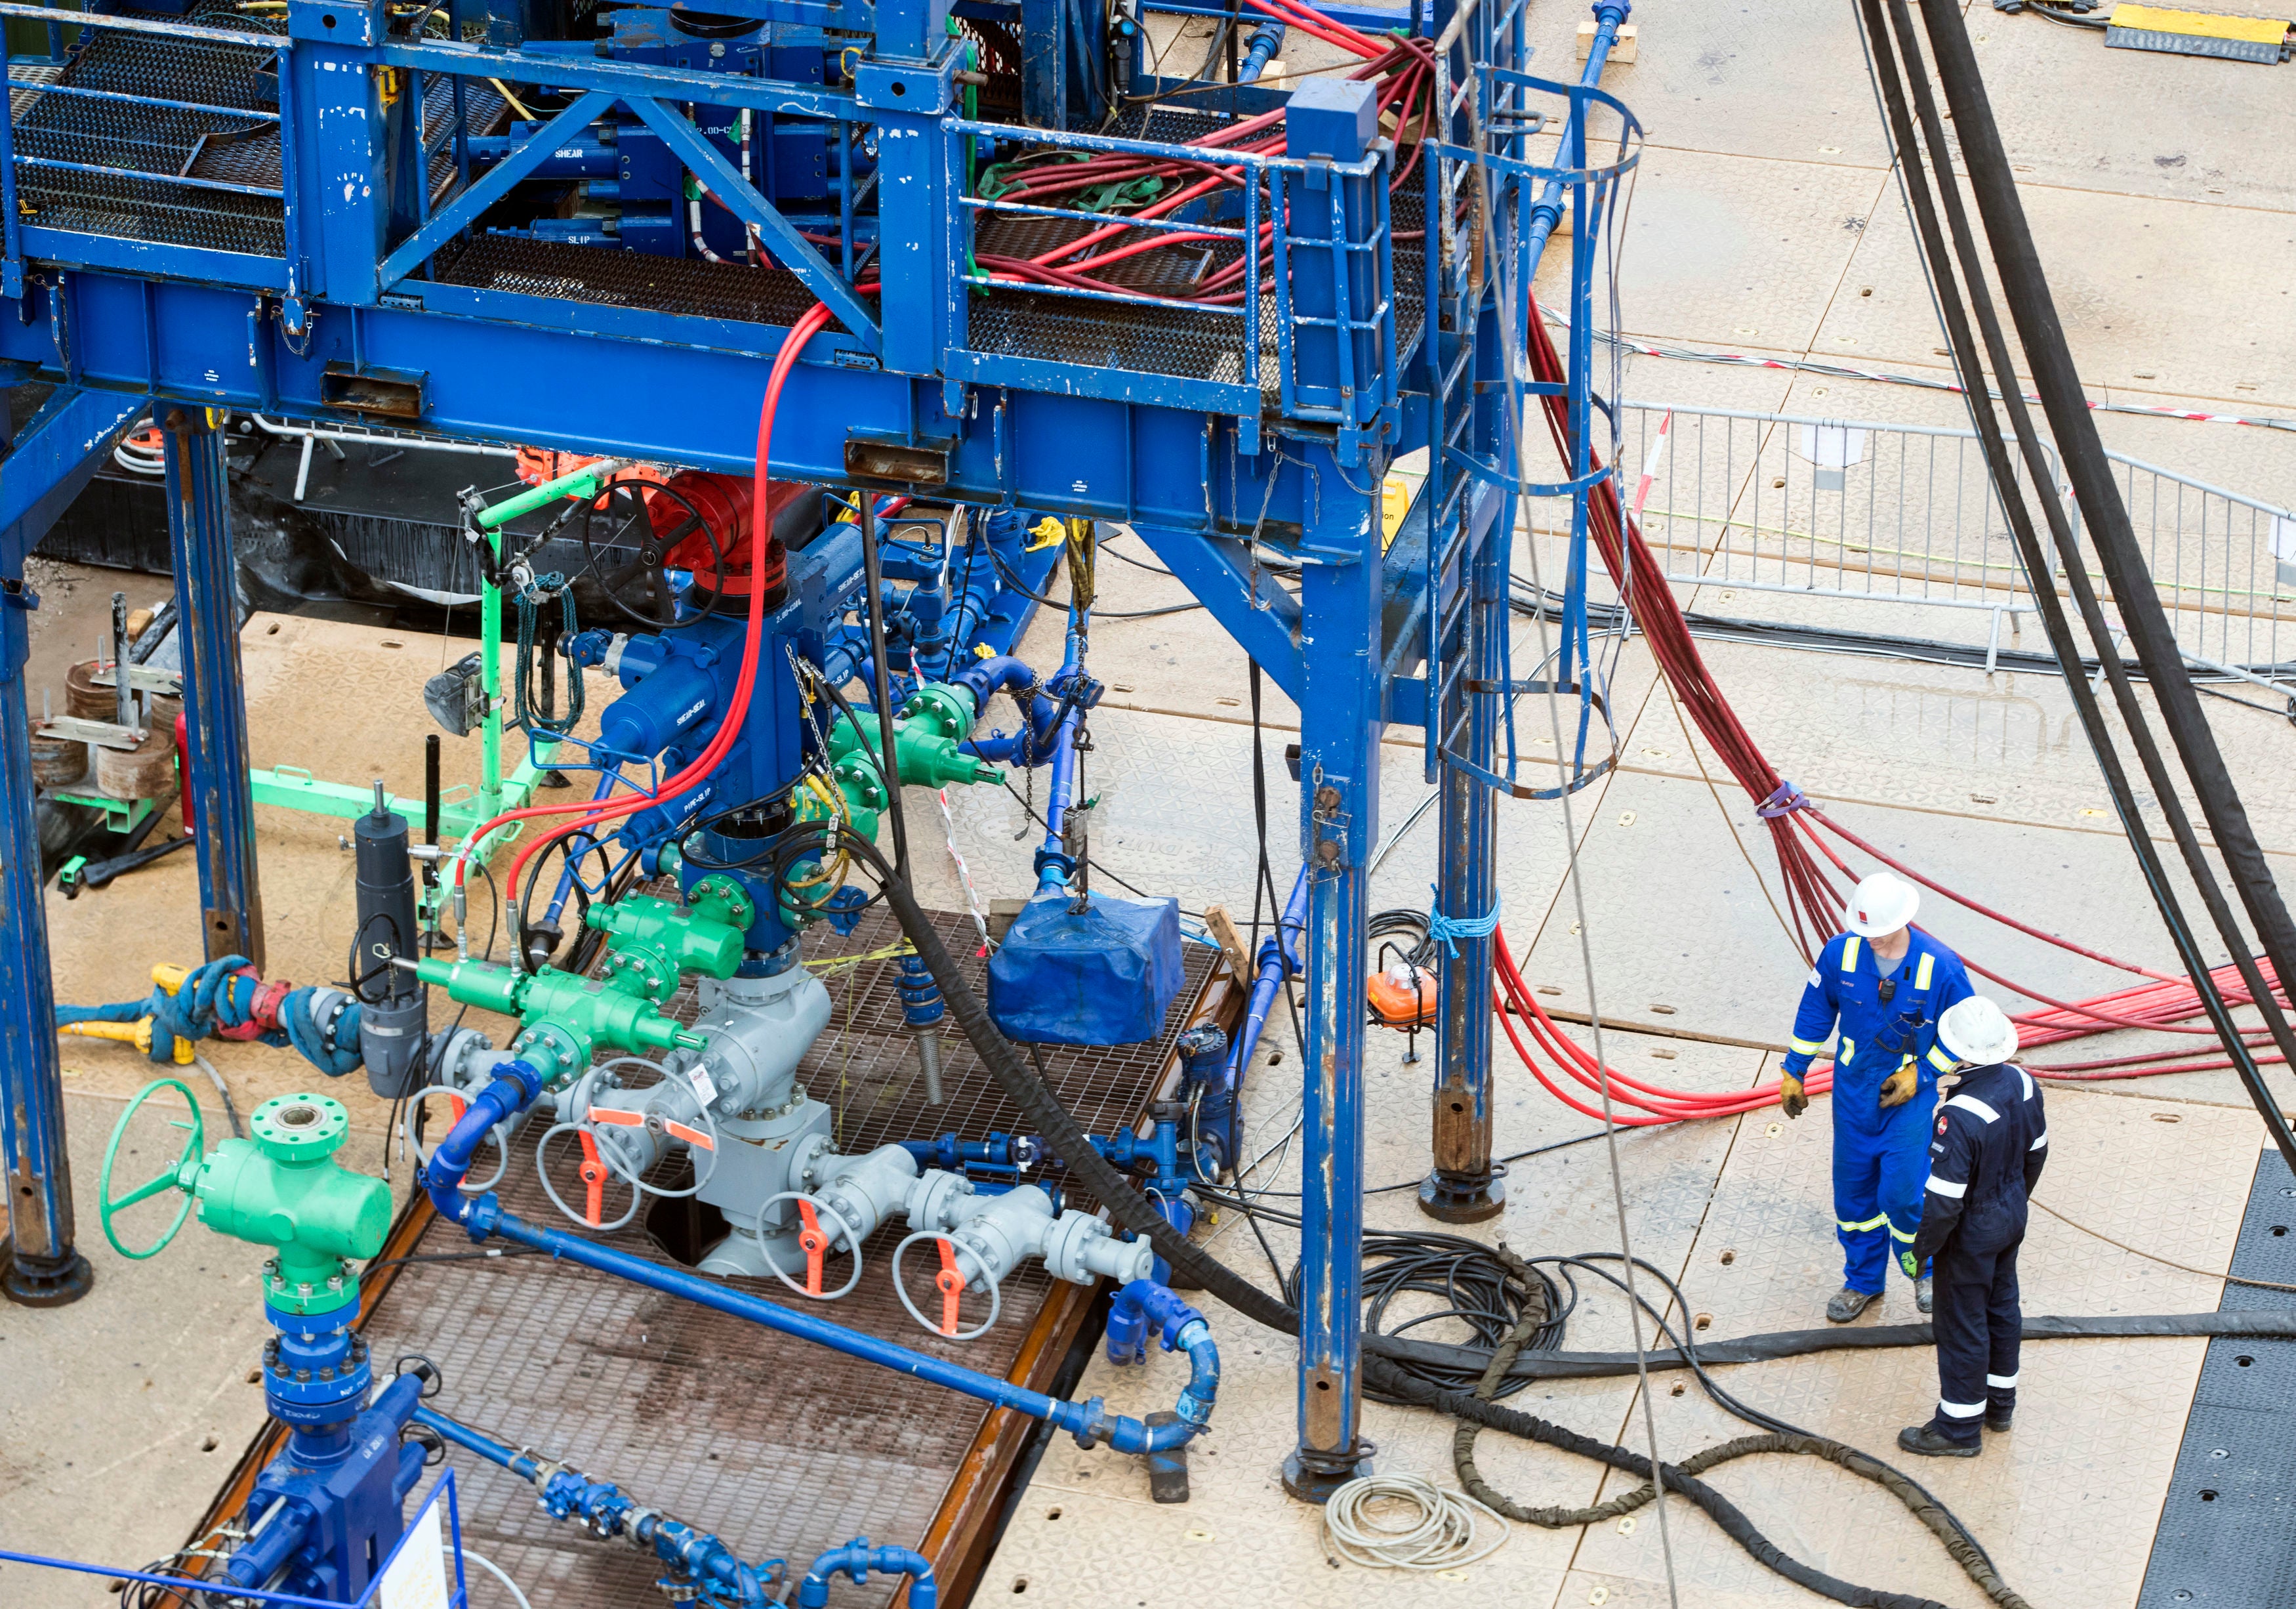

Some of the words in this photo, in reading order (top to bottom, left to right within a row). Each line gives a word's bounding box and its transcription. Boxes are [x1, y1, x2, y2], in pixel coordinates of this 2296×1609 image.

[555, 149, 583, 158] SHEAR
[568, 236, 590, 244] SLIP
[838, 566, 866, 593] SHEAR-SEAL
[676, 698, 707, 726] SHEAR-SEAL
[684, 787, 711, 813] PIPE-SLIP
